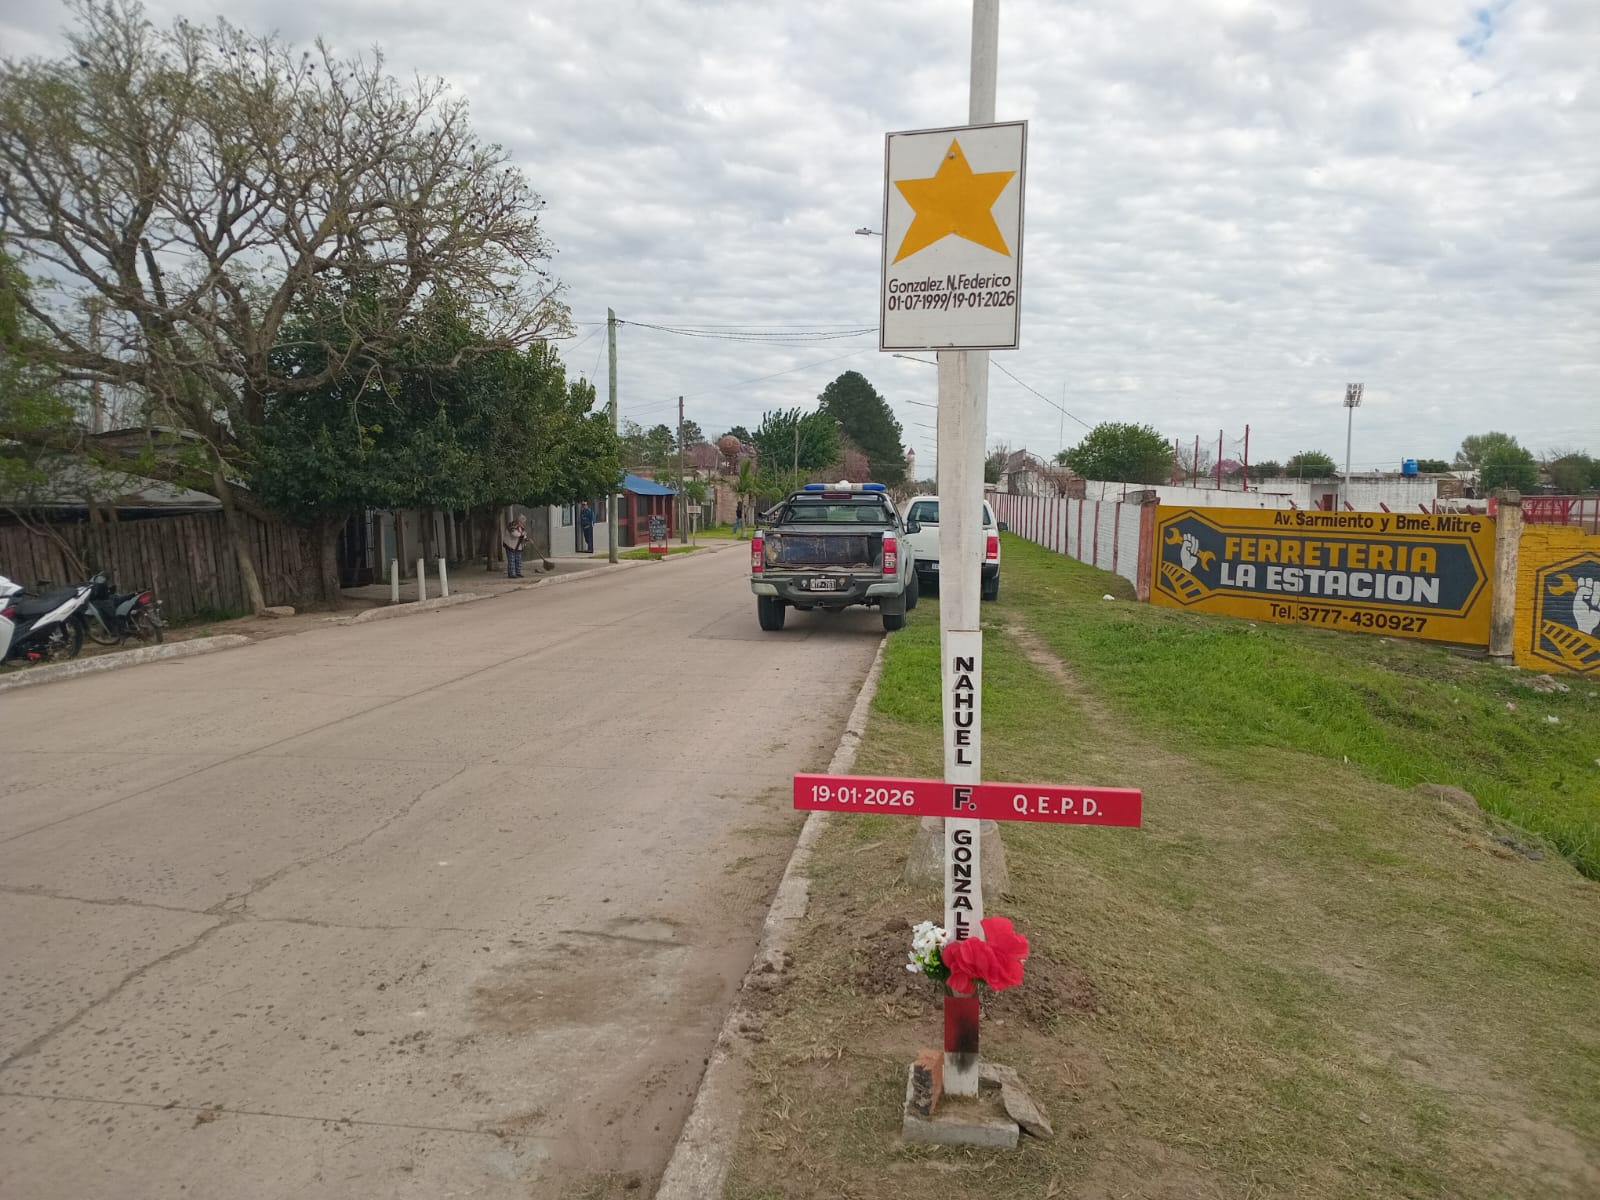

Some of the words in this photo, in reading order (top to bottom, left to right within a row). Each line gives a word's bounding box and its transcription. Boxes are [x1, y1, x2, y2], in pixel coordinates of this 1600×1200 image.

[1274, 511, 1293, 526] Av.
[1296, 511, 1374, 529] Sarmiento
[1379, 518, 1390, 532] y
[1225, 536, 1438, 574] FERRETERIA
[1220, 562, 1256, 589] LA
[1266, 565, 1440, 604] ESTACION
[953, 656, 975, 766] NAHUEL
[952, 829, 973, 941] GONZALE
